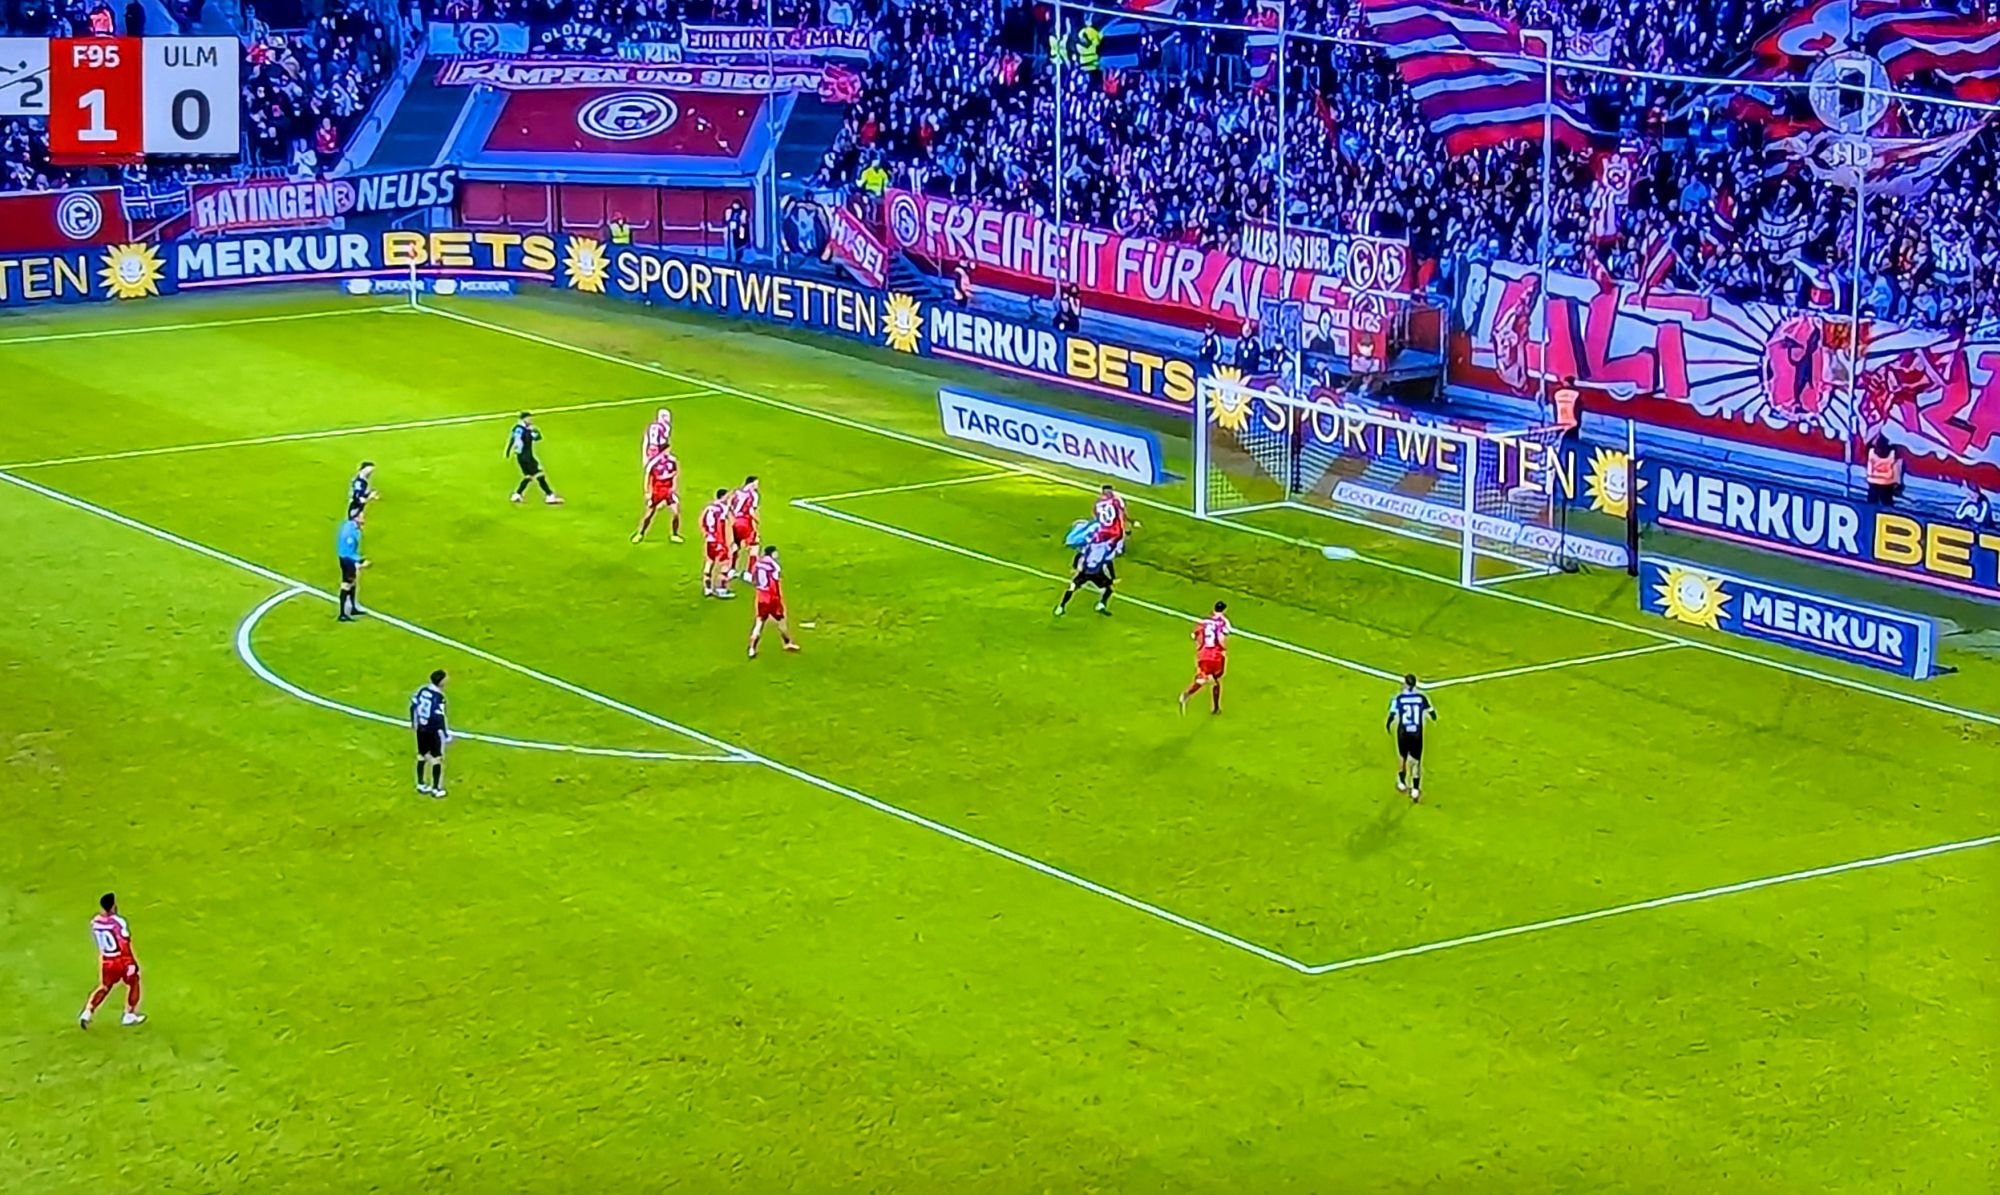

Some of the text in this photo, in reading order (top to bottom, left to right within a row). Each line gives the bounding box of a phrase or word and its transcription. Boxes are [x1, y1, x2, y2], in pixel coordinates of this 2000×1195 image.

[636, 70, 692, 84] UND
[198, 169, 455, 229] RATINGEN NEUSS
[178, 231, 557, 279] MERKUR BETS
[925, 202, 1107, 288] FREIHEIT
[1117, 236, 1203, 307] FÜR
[617, 252, 876, 337] SPORTWETTEN
[930, 307, 1196, 403] MERKUR BETS
[1262, 386, 1576, 500] SPORTWETEN
[1658, 467, 1860, 554] MERKUR
[1743, 591, 1902, 658] MERKUR
[1401, 703, 1420, 726] 21
